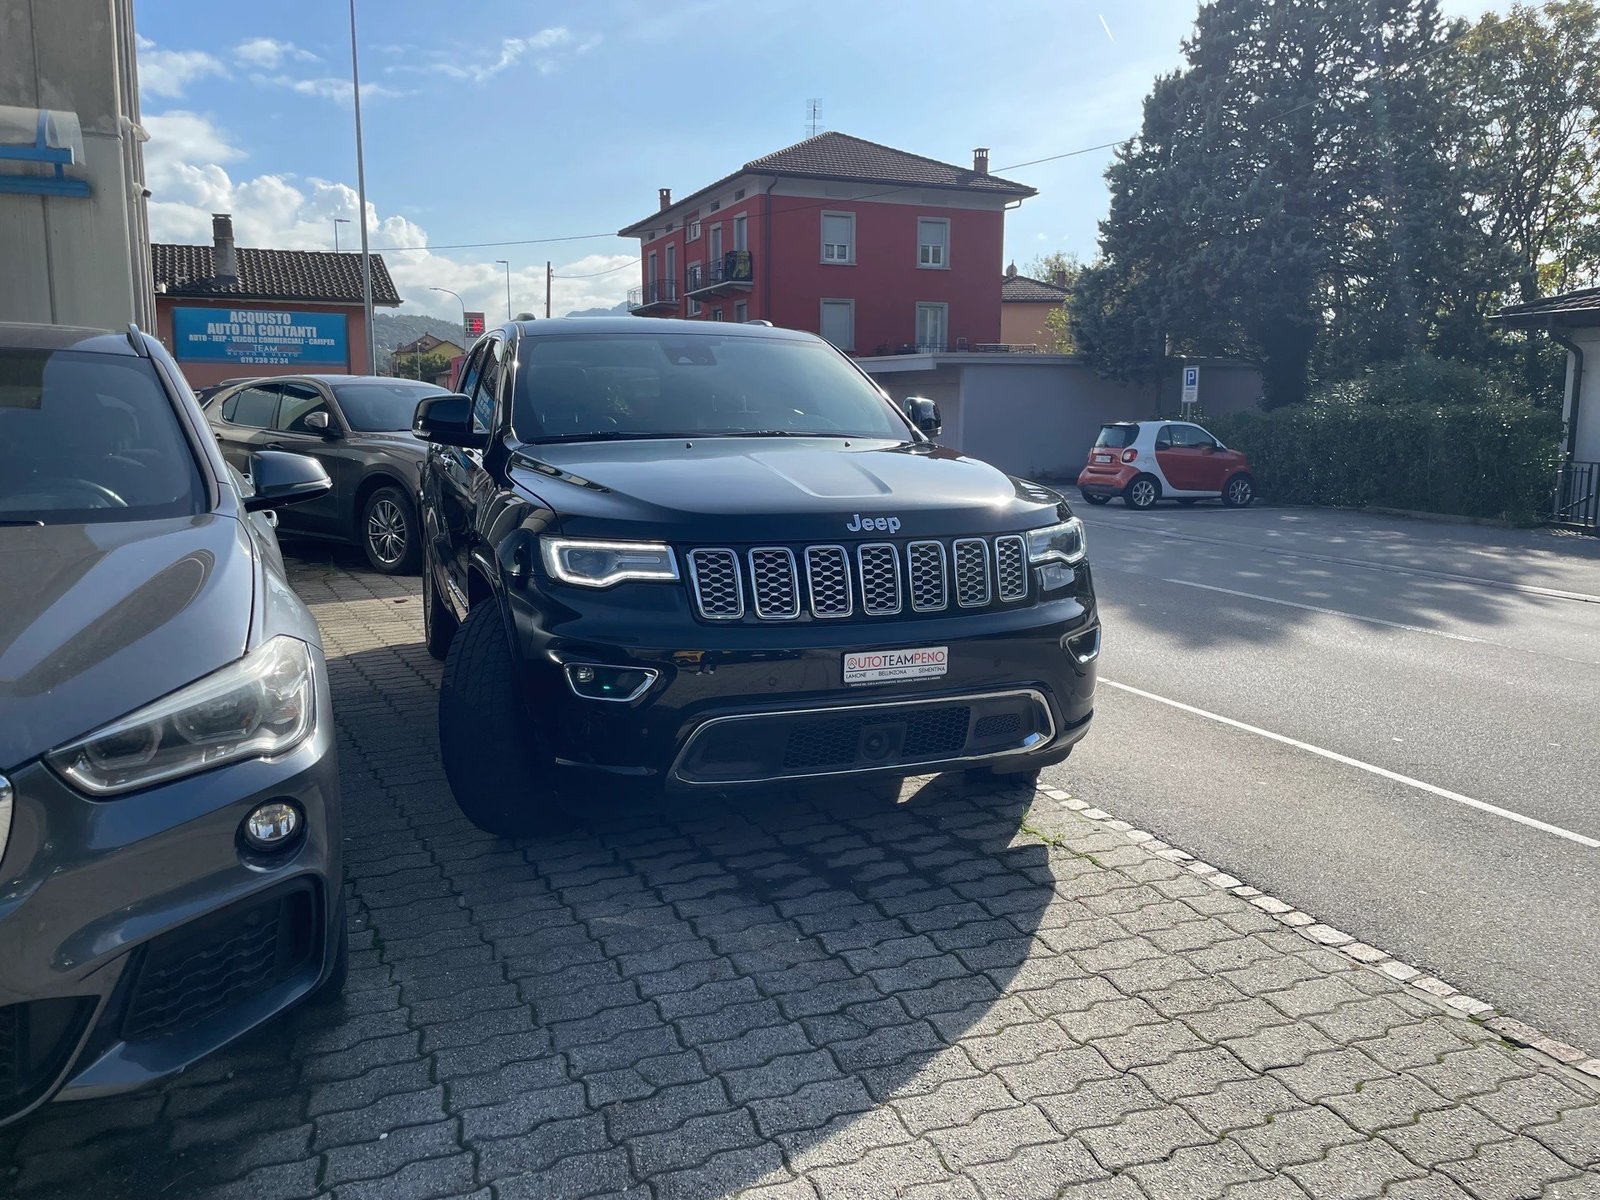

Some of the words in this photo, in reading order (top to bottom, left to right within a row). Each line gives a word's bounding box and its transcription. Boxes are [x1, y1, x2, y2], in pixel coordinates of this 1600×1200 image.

[229, 311, 292, 325] ACQUISTO
[207, 322, 240, 335] AUTO
[242, 324, 256, 336] IN
[258, 324, 317, 338] CONTANTI
[188, 334, 208, 342] AUTO
[212, 335, 227, 343] JEEP
[232, 336, 258, 344] VEICOLI
[258, 337, 304, 345] COMMERCIALI
[1187, 371, 1195, 385] P
[846, 513, 902, 534] Jeep
[878, 669, 907, 677] BELLINZONA
[918, 666, 946, 674] SEMENTINA
